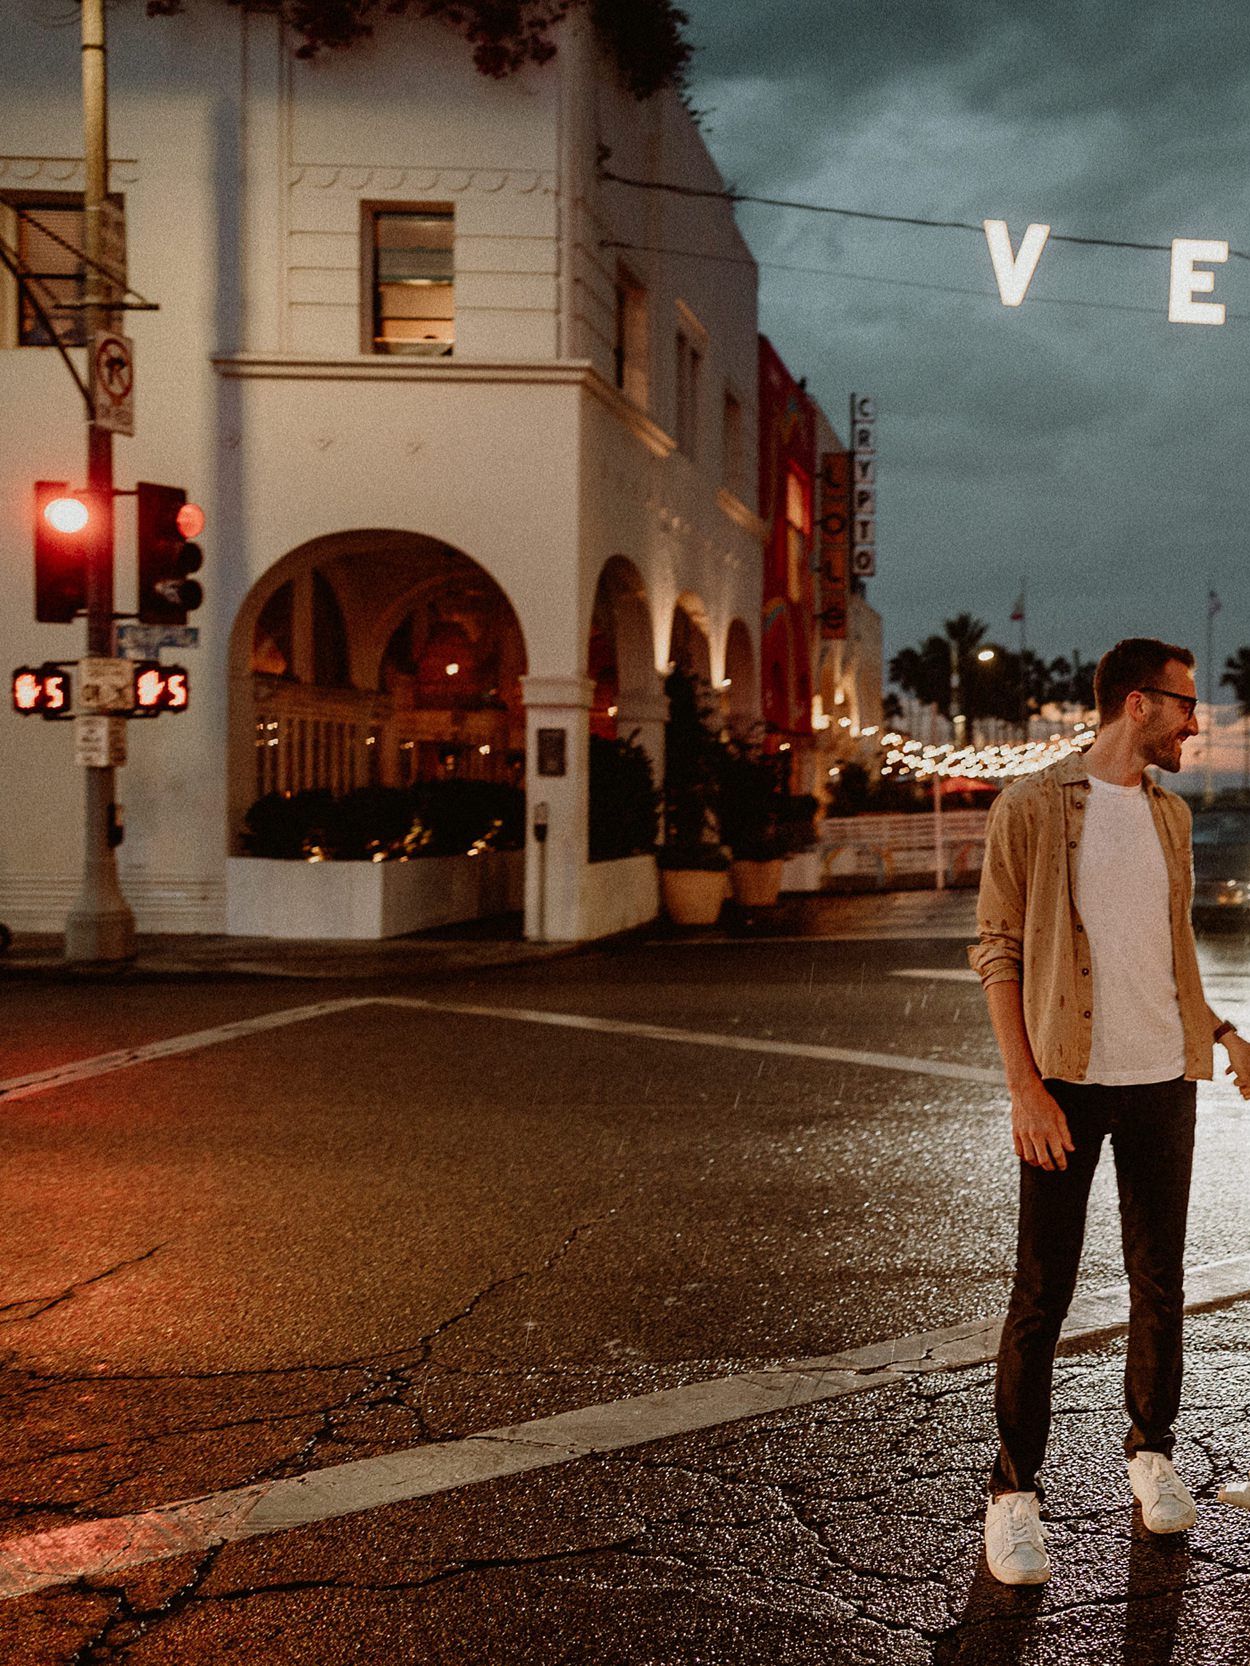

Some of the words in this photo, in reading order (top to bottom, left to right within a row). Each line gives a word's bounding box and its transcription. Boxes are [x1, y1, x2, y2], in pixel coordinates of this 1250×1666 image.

[856, 397, 872, 570] CRYPTO
[44, 676, 64, 708] 5
[167, 674, 188, 706] 5
